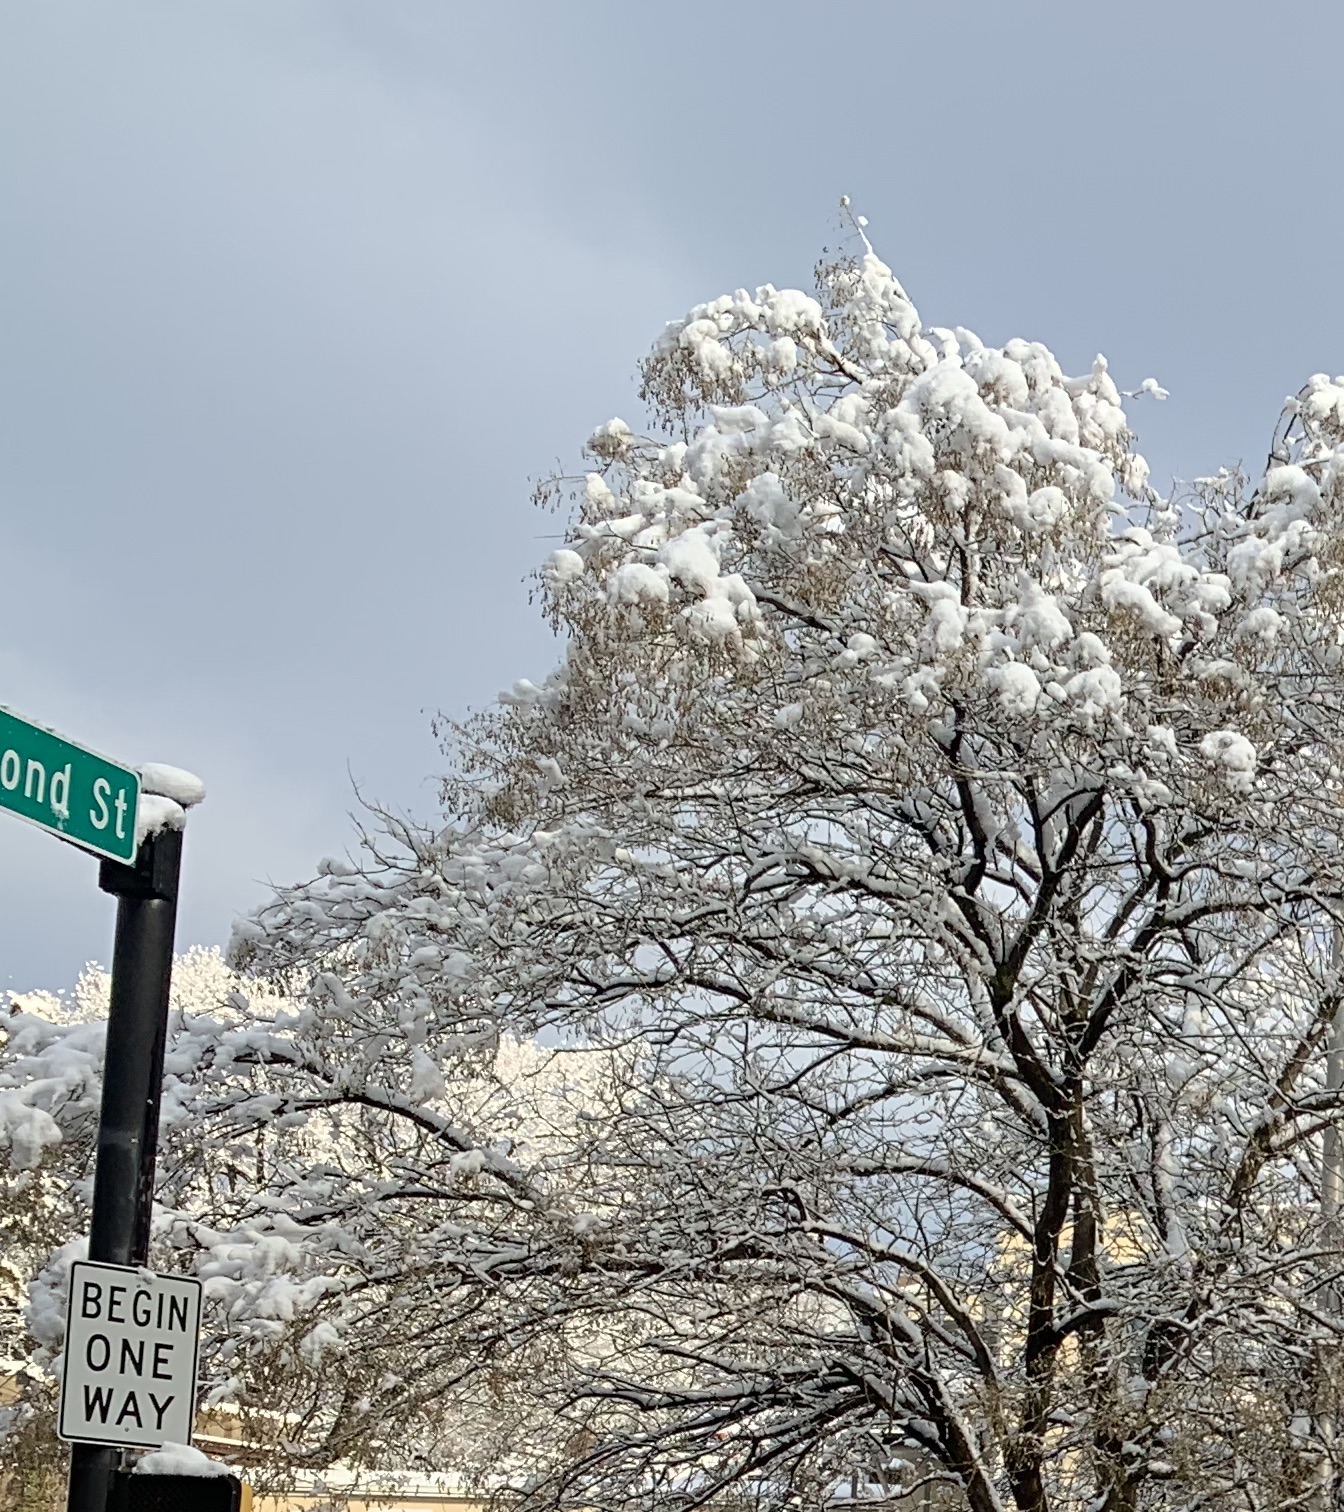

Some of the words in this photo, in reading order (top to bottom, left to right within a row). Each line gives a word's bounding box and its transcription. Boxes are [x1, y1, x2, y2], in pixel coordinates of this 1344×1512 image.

[90, 777, 127, 839] St
[81, 1281, 188, 1332] BEGIN
[86, 1334, 174, 1380] ONE
[84, 1385, 175, 1430] WAY
